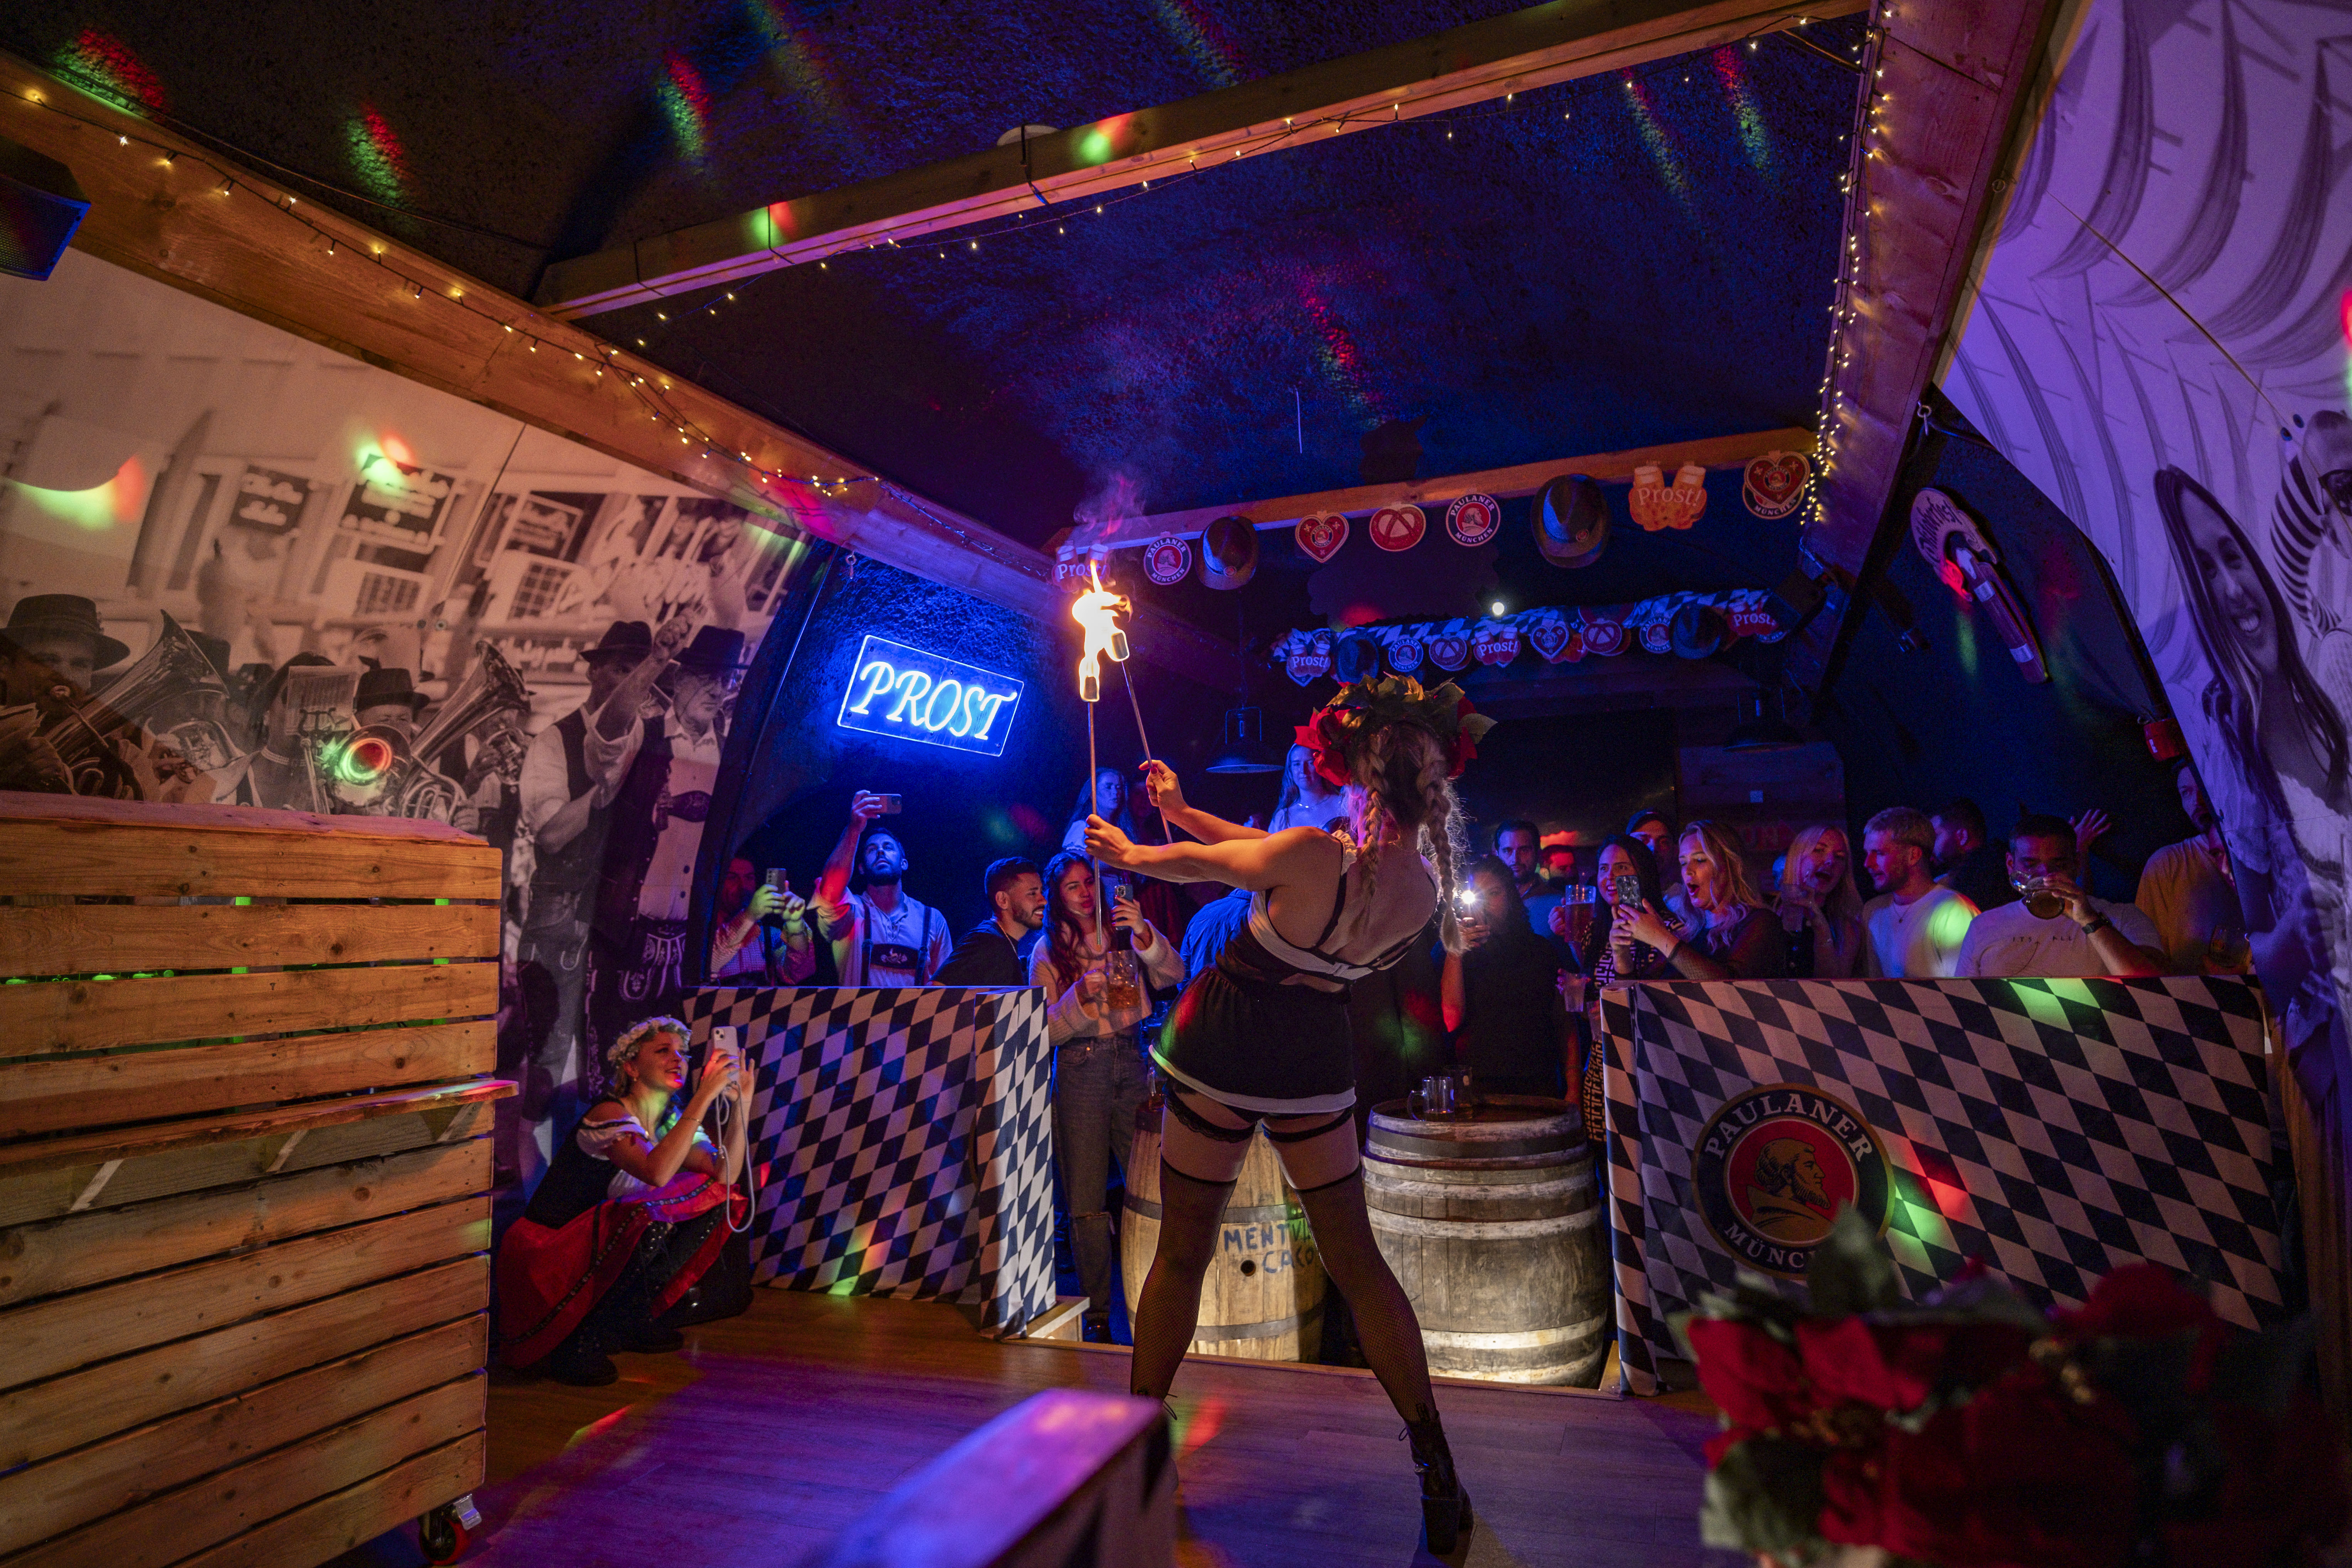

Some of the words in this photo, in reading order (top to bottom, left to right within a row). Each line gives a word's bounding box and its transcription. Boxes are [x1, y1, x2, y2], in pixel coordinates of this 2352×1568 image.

[1450, 495, 1495, 516] PAULANER
[1637, 487, 1703, 506] Prost!
[1455, 527, 1493, 543] MÜNCHEN
[1147, 538, 1186, 558] PAULANER
[1151, 568, 1185, 582] MÜNCHEN
[1478, 640, 1518, 656] Prost!
[1292, 656, 1329, 668] Prost!
[849, 660, 1018, 740] PROST
[1705, 1093, 1873, 1162] PAULANER
[1724, 1221, 1816, 1269] MÜNC
